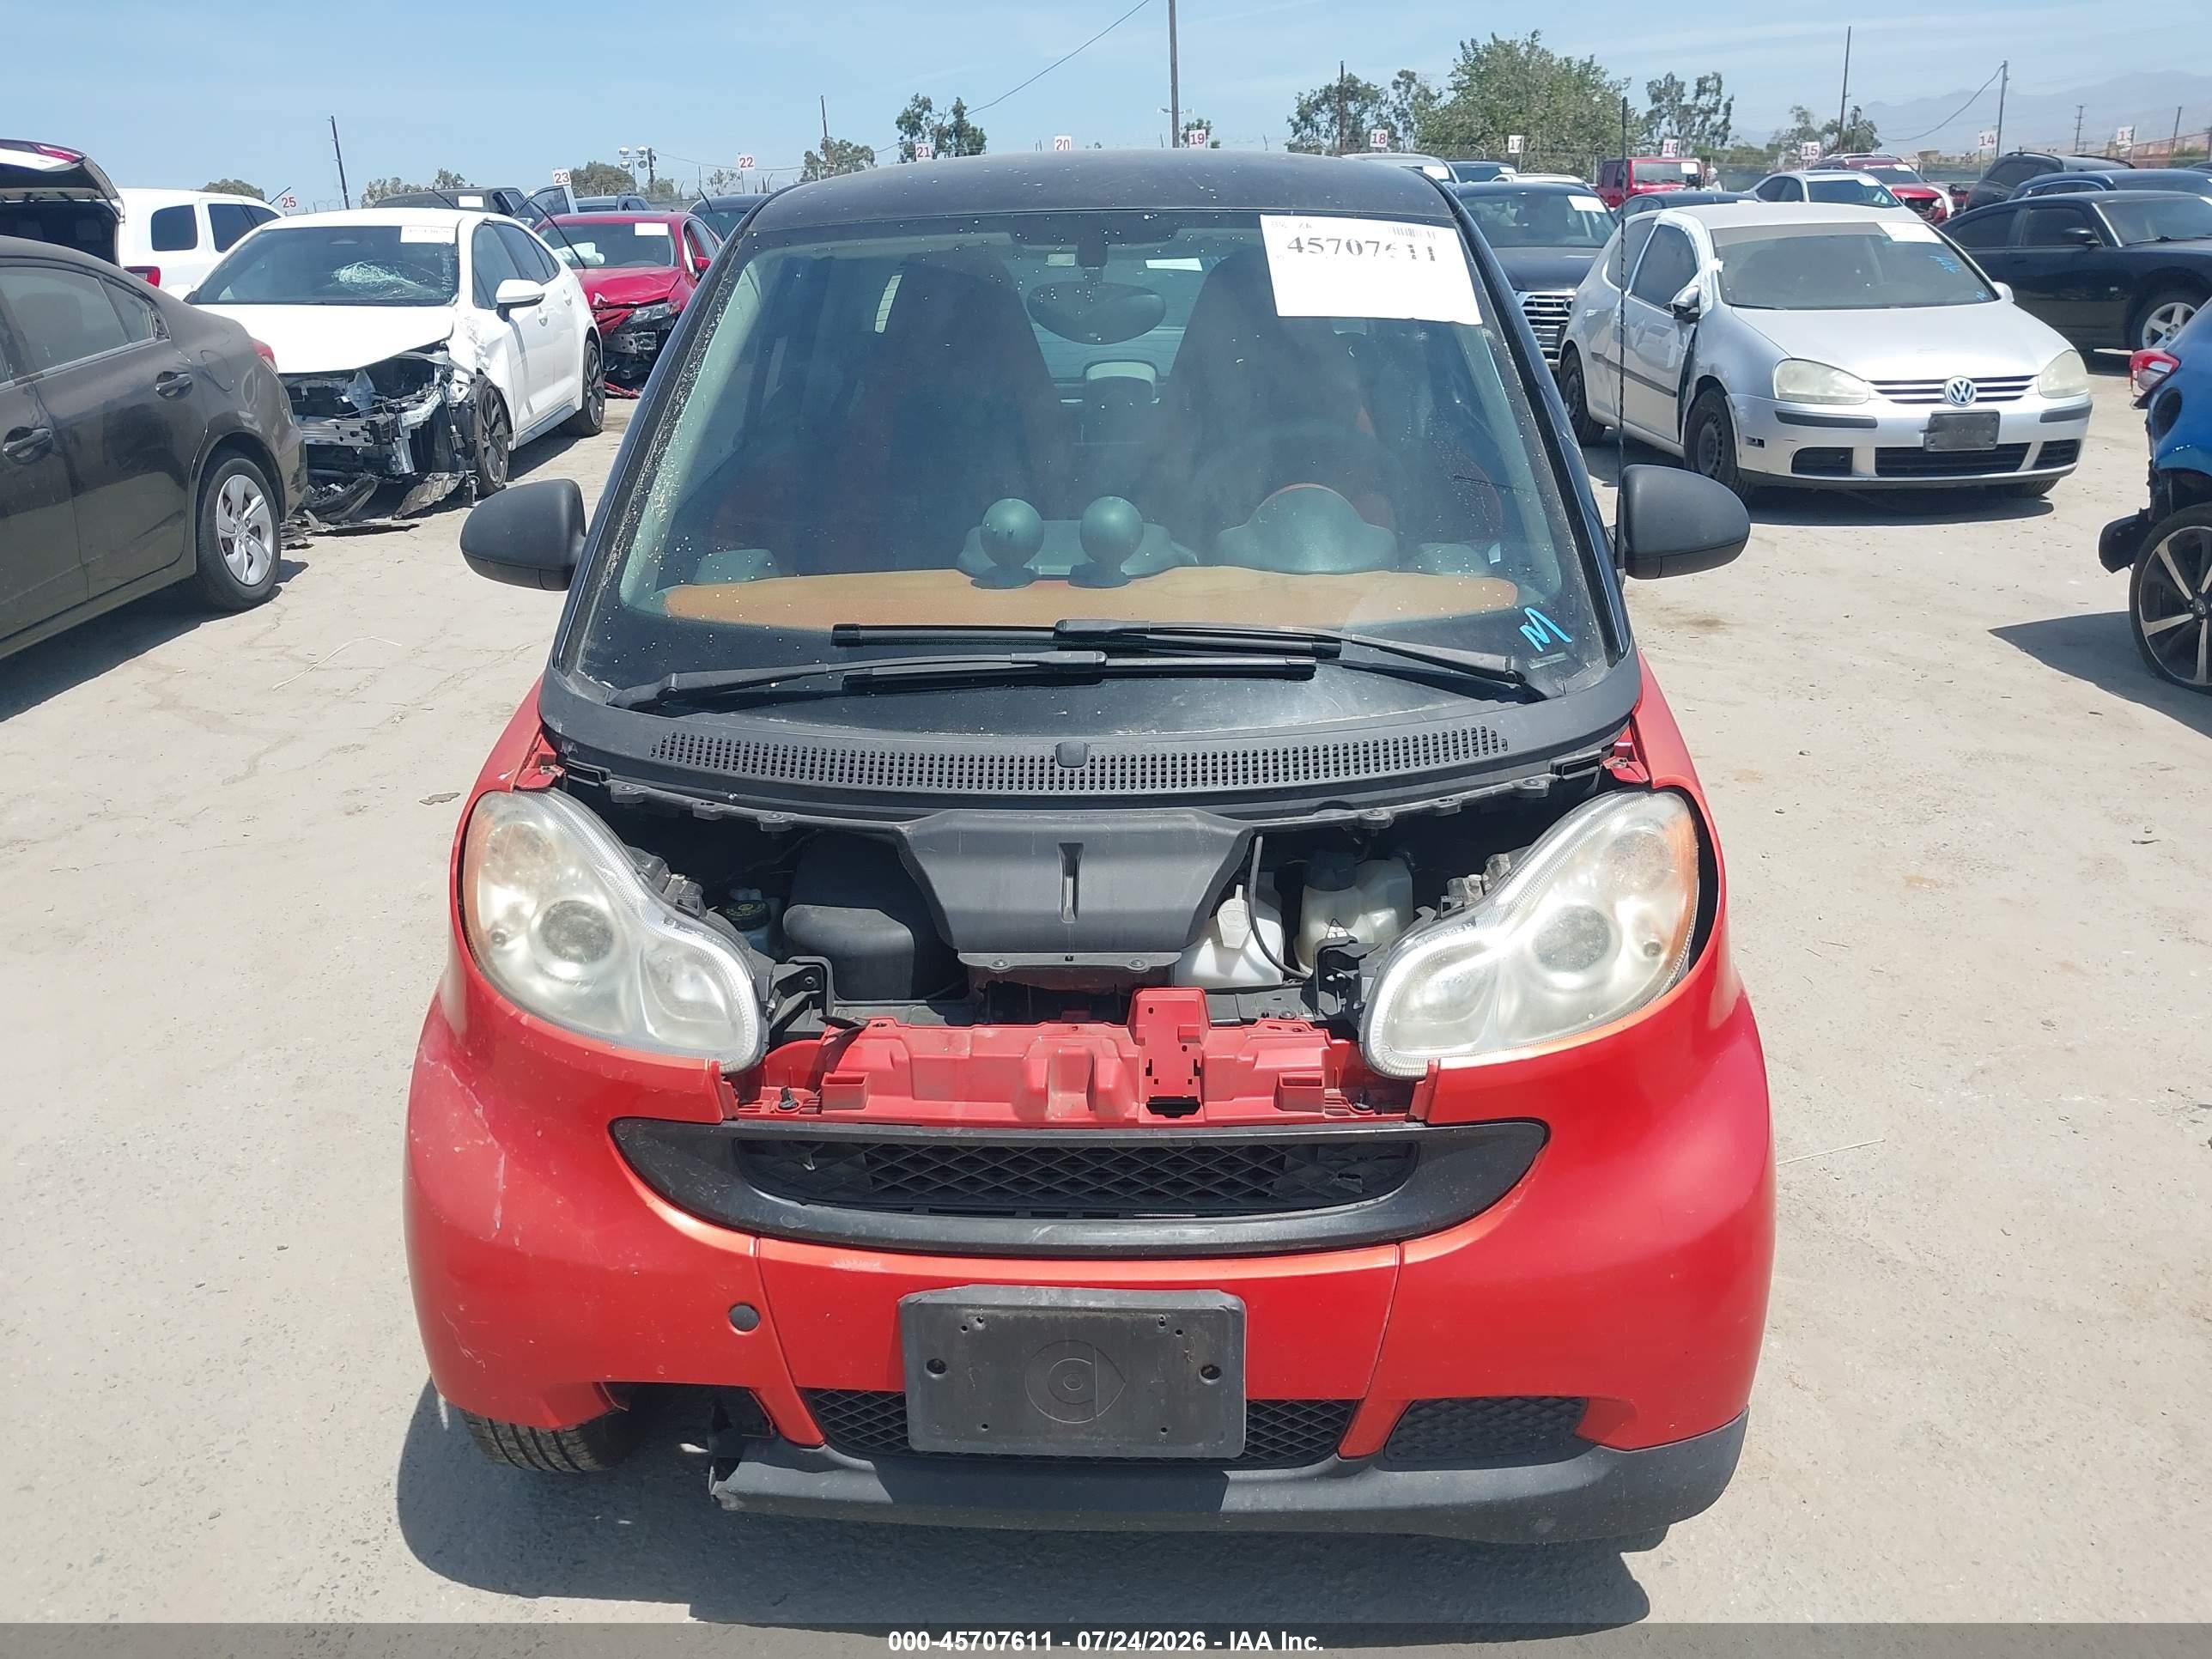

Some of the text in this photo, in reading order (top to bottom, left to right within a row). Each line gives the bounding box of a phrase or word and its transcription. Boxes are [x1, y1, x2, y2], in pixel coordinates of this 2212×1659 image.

[1190, 132, 1205, 144] 19
[1371, 133, 1386, 143] 18
[1979, 135, 1995, 146] 14
[1056, 139, 1070, 150] 20
[917, 146, 931, 157] 21
[1803, 145, 1818, 156] 15
[739, 157, 754, 168] 22
[555, 173, 569, 184] 23
[282, 197, 296, 208] 25
